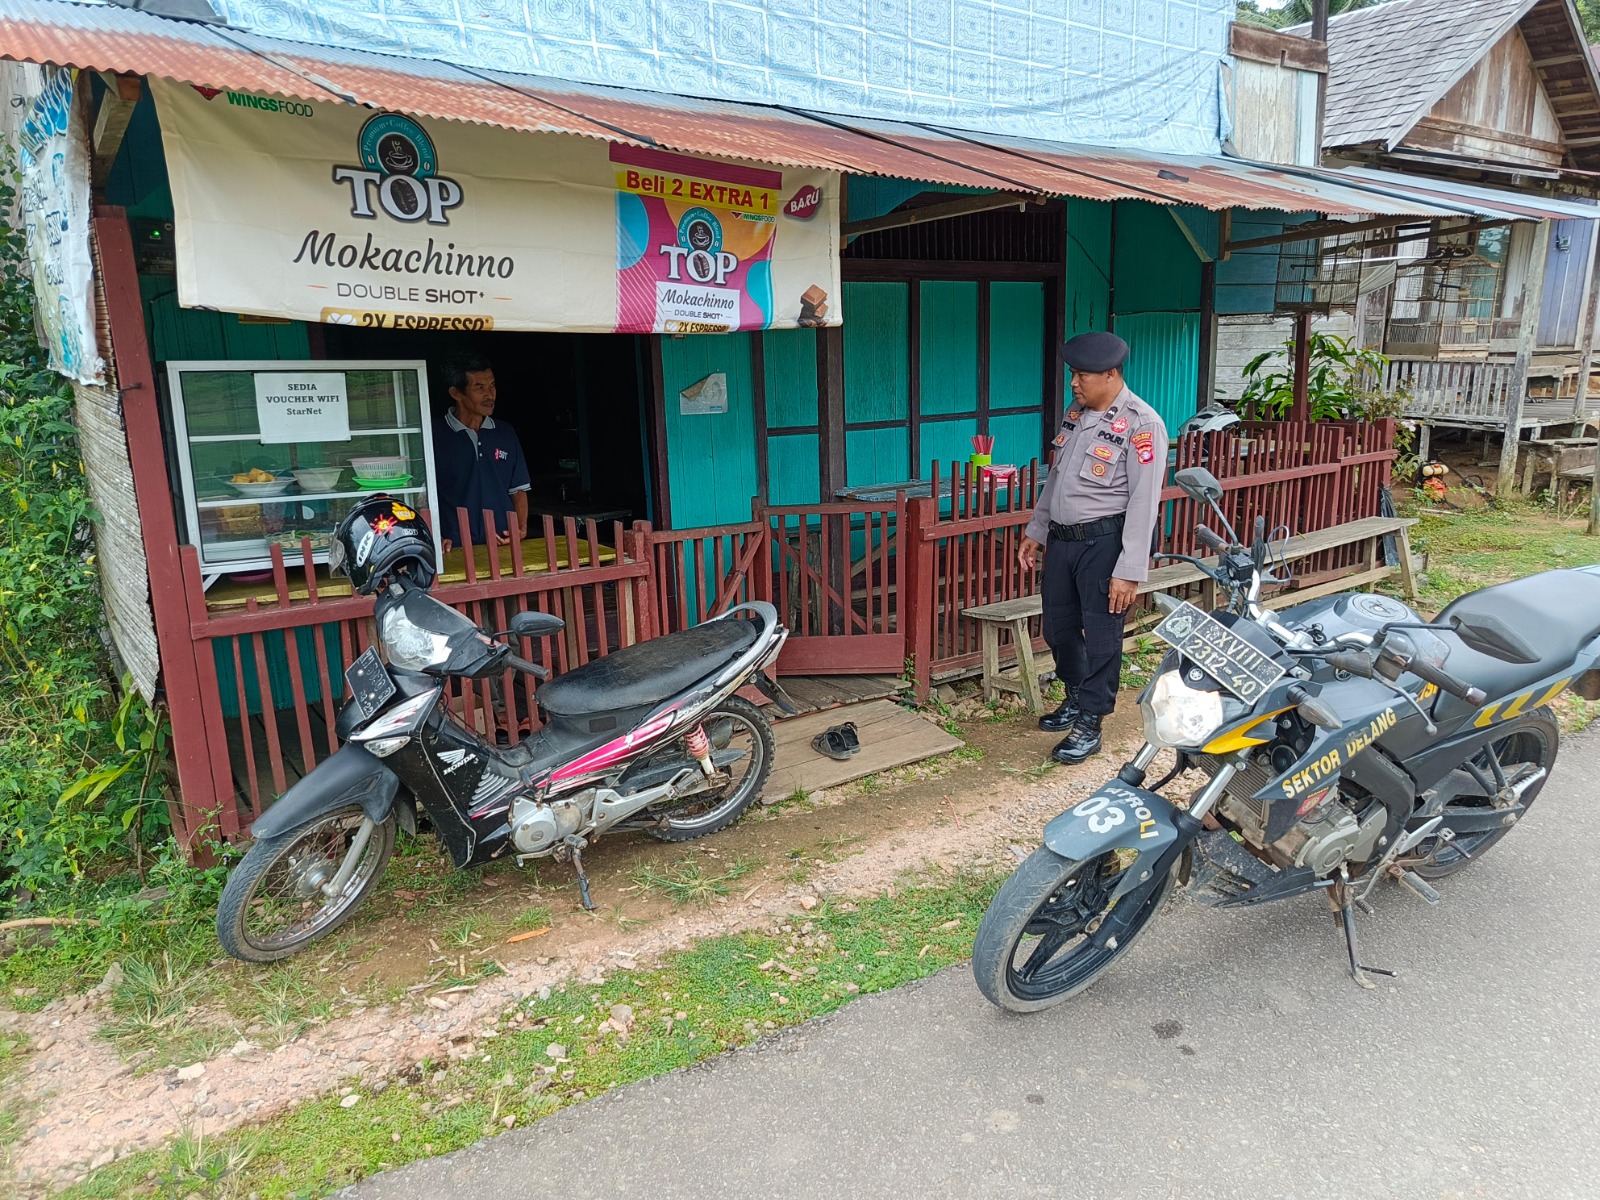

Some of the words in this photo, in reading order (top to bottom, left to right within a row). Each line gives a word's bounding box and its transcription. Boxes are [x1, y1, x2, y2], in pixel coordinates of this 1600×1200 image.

[226, 91, 314, 117] WINGSFOOD
[363, 122, 386, 152] Premium
[389, 119, 415, 135] Coffee
[415, 134, 431, 159] Blend
[334, 167, 462, 224] TOP
[626, 170, 665, 194] Beli
[671, 178, 683, 196] 2
[690, 182, 753, 207] EXTRA
[759, 192, 769, 209] 1
[790, 189, 819, 213] BARU
[742, 213, 775, 223] WINGSFOOD
[293, 230, 515, 279] Mokachinno
[660, 244, 737, 285] TOP
[337, 282, 419, 301] DOUBLE
[661, 289, 734, 309] Mokachinno
[674, 309, 702, 318] DOUBLE
[678, 321, 690, 333] 2X
[266, 395, 315, 403] VOUCHER
[317, 395, 339, 403] WIFI
[288, 383, 317, 391] SEDIA
[287, 407, 322, 415] StarNet
[1098, 430, 1124, 445] POLRI
[358, 533, 372, 562] INK
[1214, 631, 1263, 670] XVIII
[443, 753, 476, 775] HONDA
[1282, 749, 1342, 799] SEKTOR
[1345, 707, 1397, 758] DELANG
[1072, 796, 1126, 834] 03
